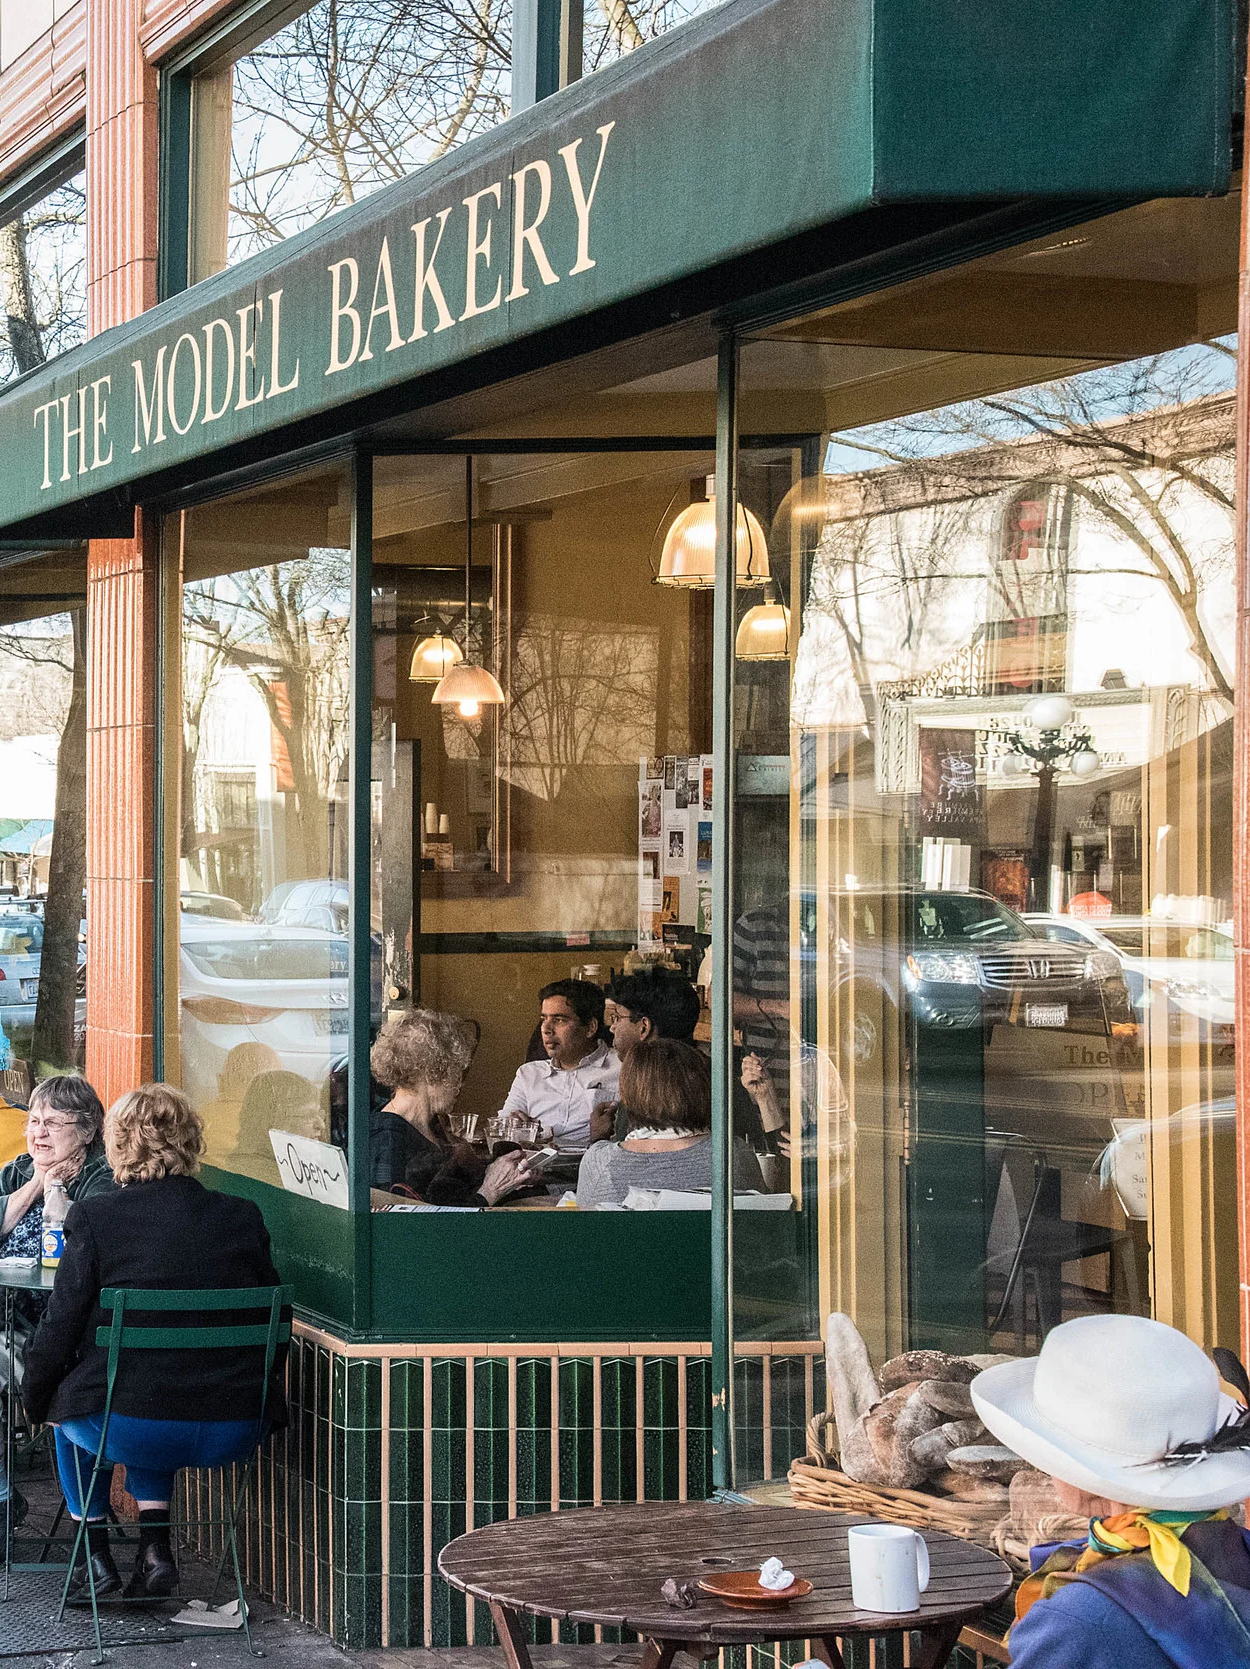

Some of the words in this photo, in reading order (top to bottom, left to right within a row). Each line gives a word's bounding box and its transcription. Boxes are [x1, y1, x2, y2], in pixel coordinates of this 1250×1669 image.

[33, 375, 112, 490] THE
[131, 289, 300, 455] MODEL
[325, 121, 616, 376] BAKERY
[73, 1024, 87, 1033] ZA
[73, 1032, 86, 1041] 20
[1064, 1045, 1110, 1065] The
[3, 1069, 25, 1095] OPEN
[286, 1142, 328, 1196] Open
